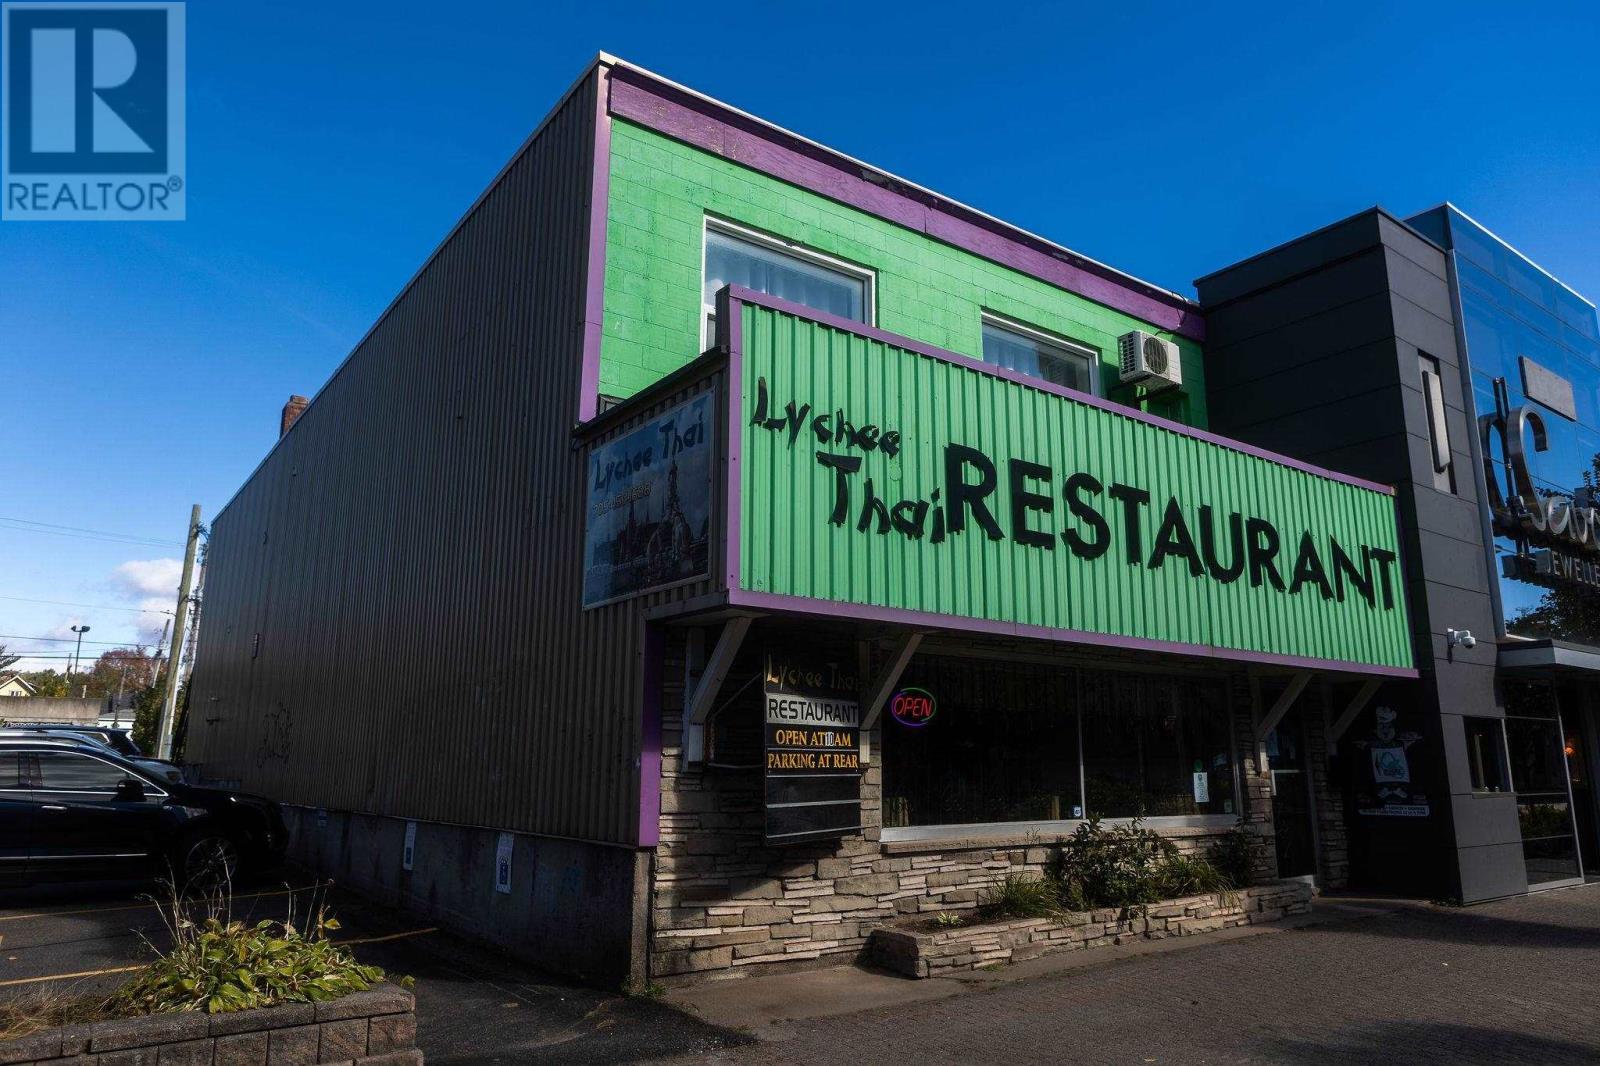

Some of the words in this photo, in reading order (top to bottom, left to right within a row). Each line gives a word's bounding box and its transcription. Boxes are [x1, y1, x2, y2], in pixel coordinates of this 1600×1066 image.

[749, 376, 901, 460] Lychee
[594, 446, 653, 493] Lychee
[659, 410, 704, 459] Thai
[816, 450, 945, 545] Thai
[944, 441, 1397, 611] RESTAURANT
[767, 653, 823, 691] Lychee
[768, 698, 858, 723] RESTAURANT
[894, 697, 933, 717] OPEN
[775, 729, 807, 745] OPEN
[767, 753, 816, 769] PARKING
[818, 753, 832, 768] AT
[834, 754, 859, 769] REAR
